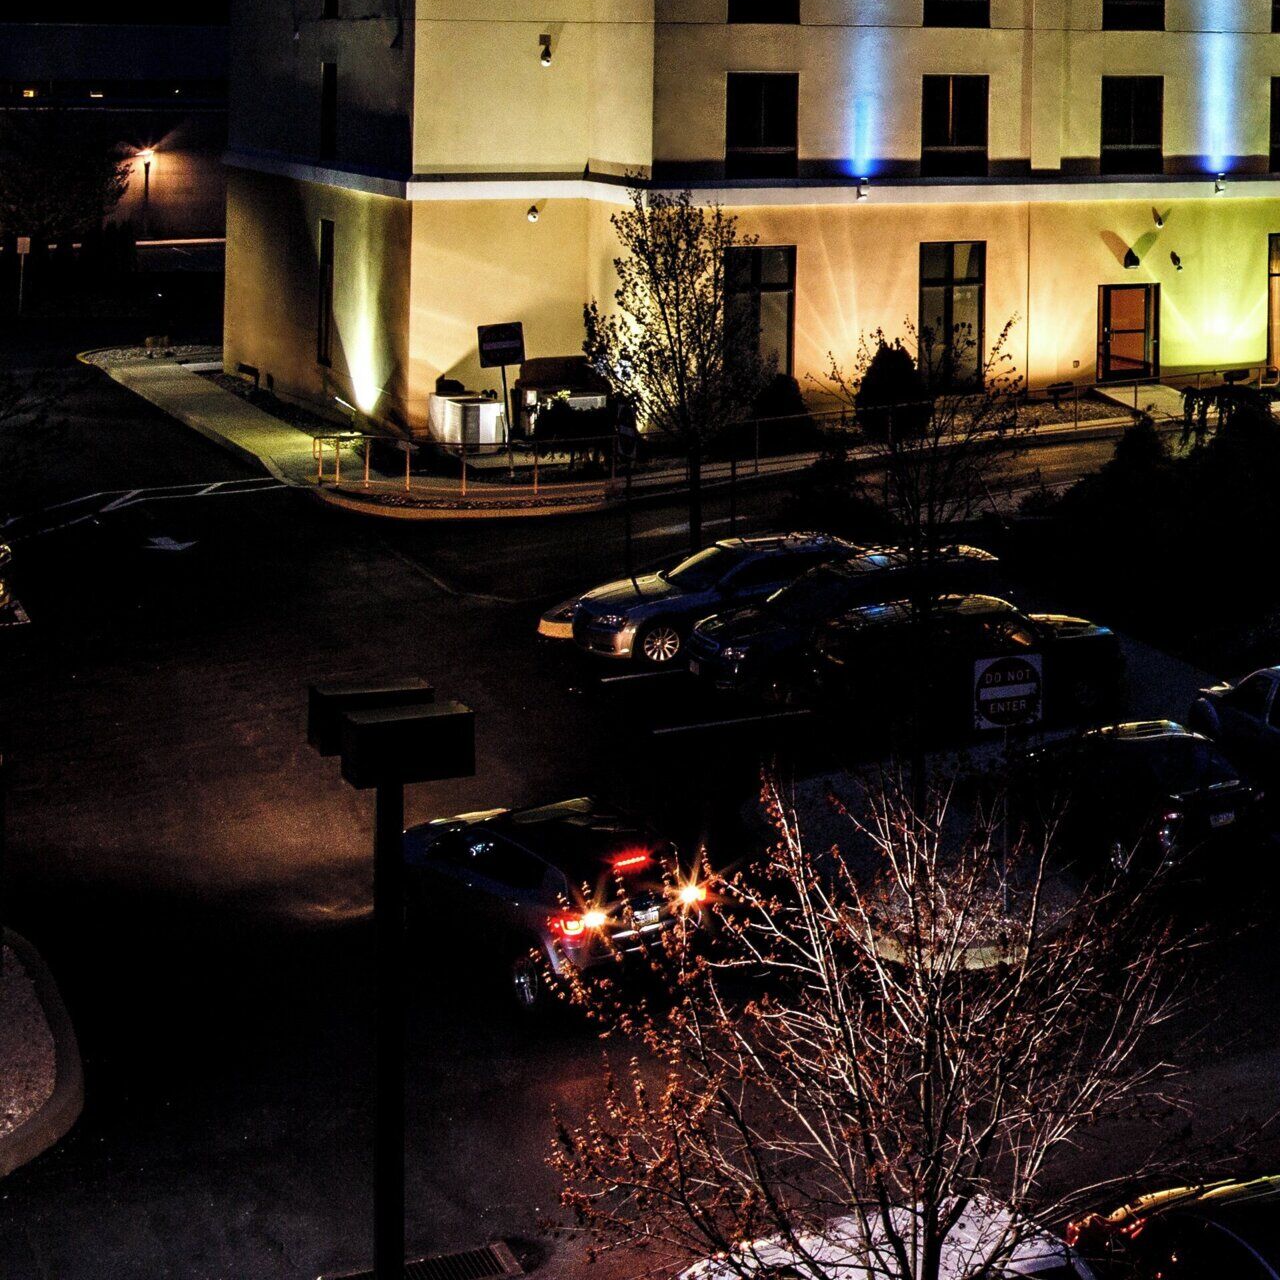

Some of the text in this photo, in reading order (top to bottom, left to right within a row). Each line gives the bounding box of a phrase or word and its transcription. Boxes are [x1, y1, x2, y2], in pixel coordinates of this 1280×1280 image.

[985, 669, 1031, 684] DO NOT
[990, 700, 1027, 715] ENTER
